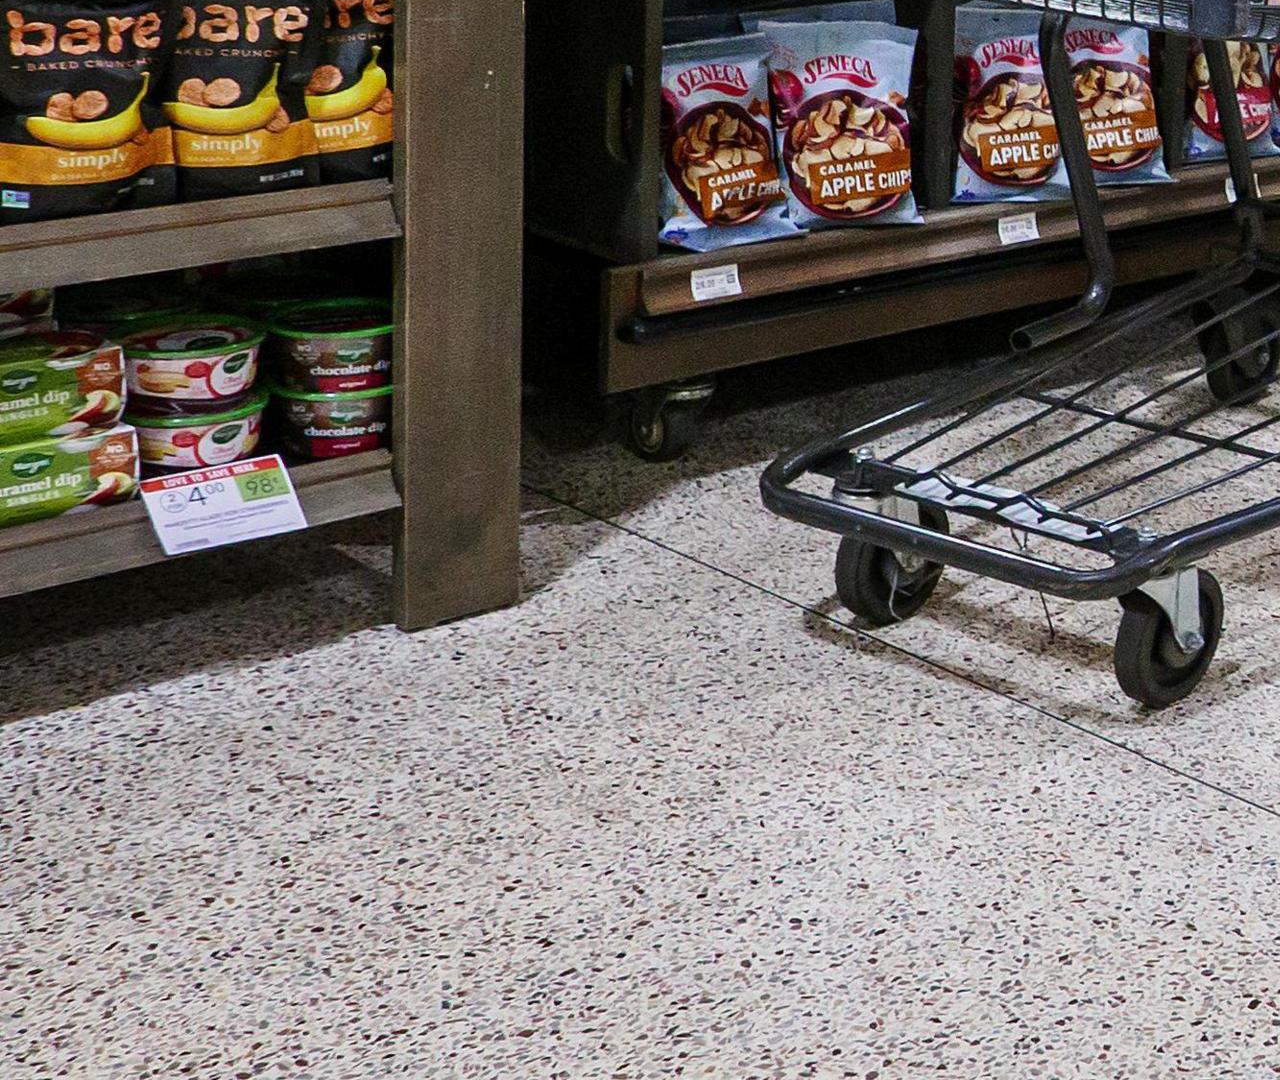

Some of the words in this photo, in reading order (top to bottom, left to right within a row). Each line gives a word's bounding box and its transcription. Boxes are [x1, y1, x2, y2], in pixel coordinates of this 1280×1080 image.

[6, 10, 161, 56] bare
[1064, 29, 1119, 53] SENECA
[219, 48, 281, 58] CRUNC
[979, 36, 1037, 68] SENECA
[27, 61, 79, 72] BAKED
[804, 54, 877, 84] SENECA
[676, 64, 749, 92] SENECA
[315, 117, 372, 139] imply
[1084, 117, 1133, 131] CARAMEL
[191, 135, 262, 154] simply
[989, 131, 1041, 146] CARAMEL
[1086, 129, 1134, 151] APPLE
[1135, 125, 1161, 143] CHIP
[57, 149, 129, 169] simply
[990, 144, 1040, 166] APPLE
[820, 159, 876, 176] CARAMEL
[708, 169, 757, 188] CARAMEL
[821, 173, 876, 198] APPLE
[310, 365, 372, 376] chocolate
[0, 392, 39, 411] amel
[43, 390, 70, 405] dip
[304, 426, 366, 437] chocolate
[368, 422, 386, 434] dip
[0, 476, 51, 498] ramel
[55, 473, 81, 488] dip
[162, 476, 187, 488] LOVE
[189, 473, 204, 483] TO
[207, 467, 230, 478] SAVE
